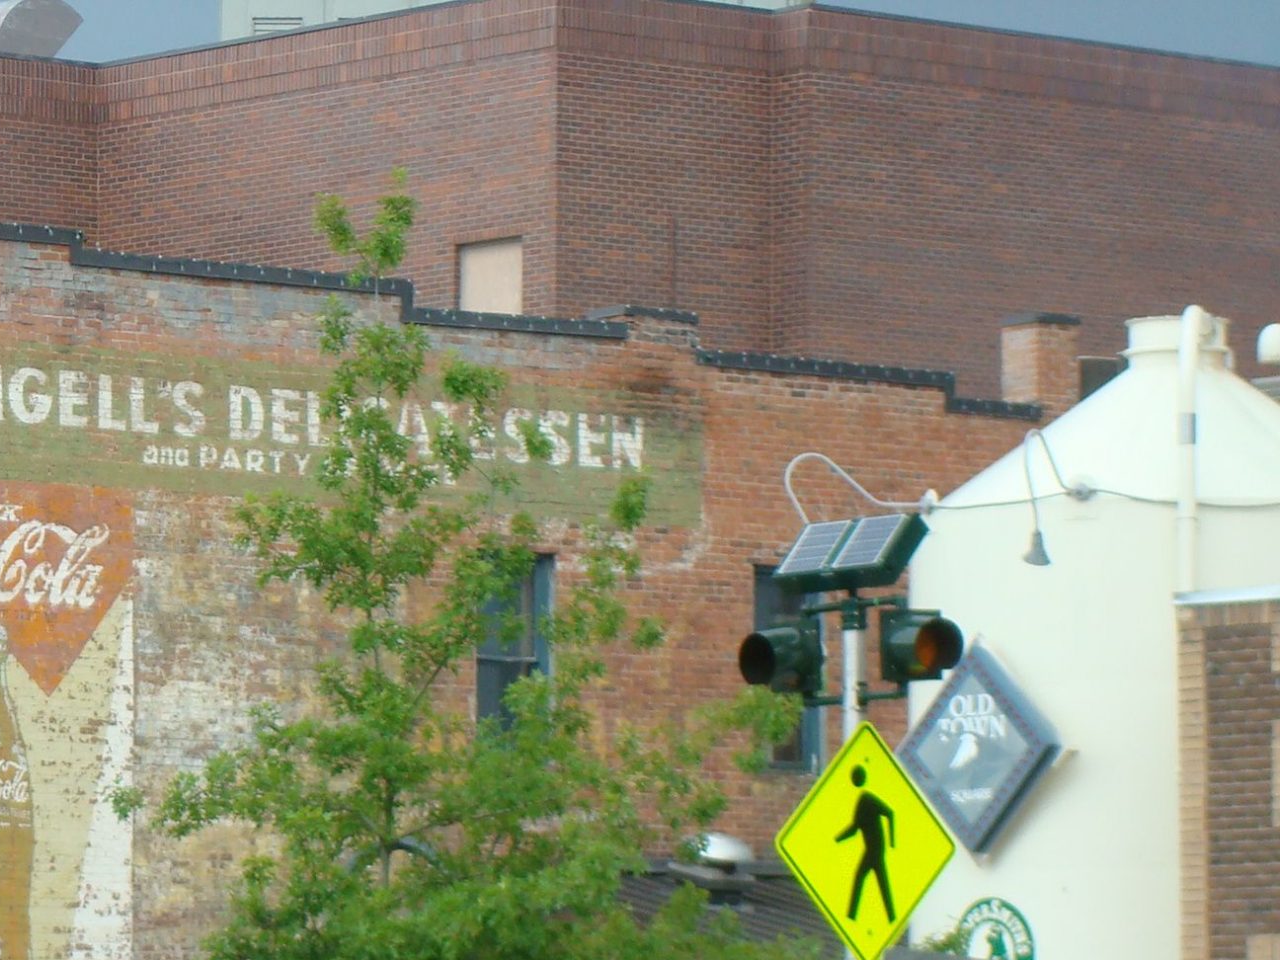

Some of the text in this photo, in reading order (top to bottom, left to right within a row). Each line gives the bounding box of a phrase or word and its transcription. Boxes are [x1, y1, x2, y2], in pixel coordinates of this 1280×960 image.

[199, 446, 311, 476] PARTY
[949, 693, 995, 716] OLD
[938, 713, 1007, 741] TOWN
